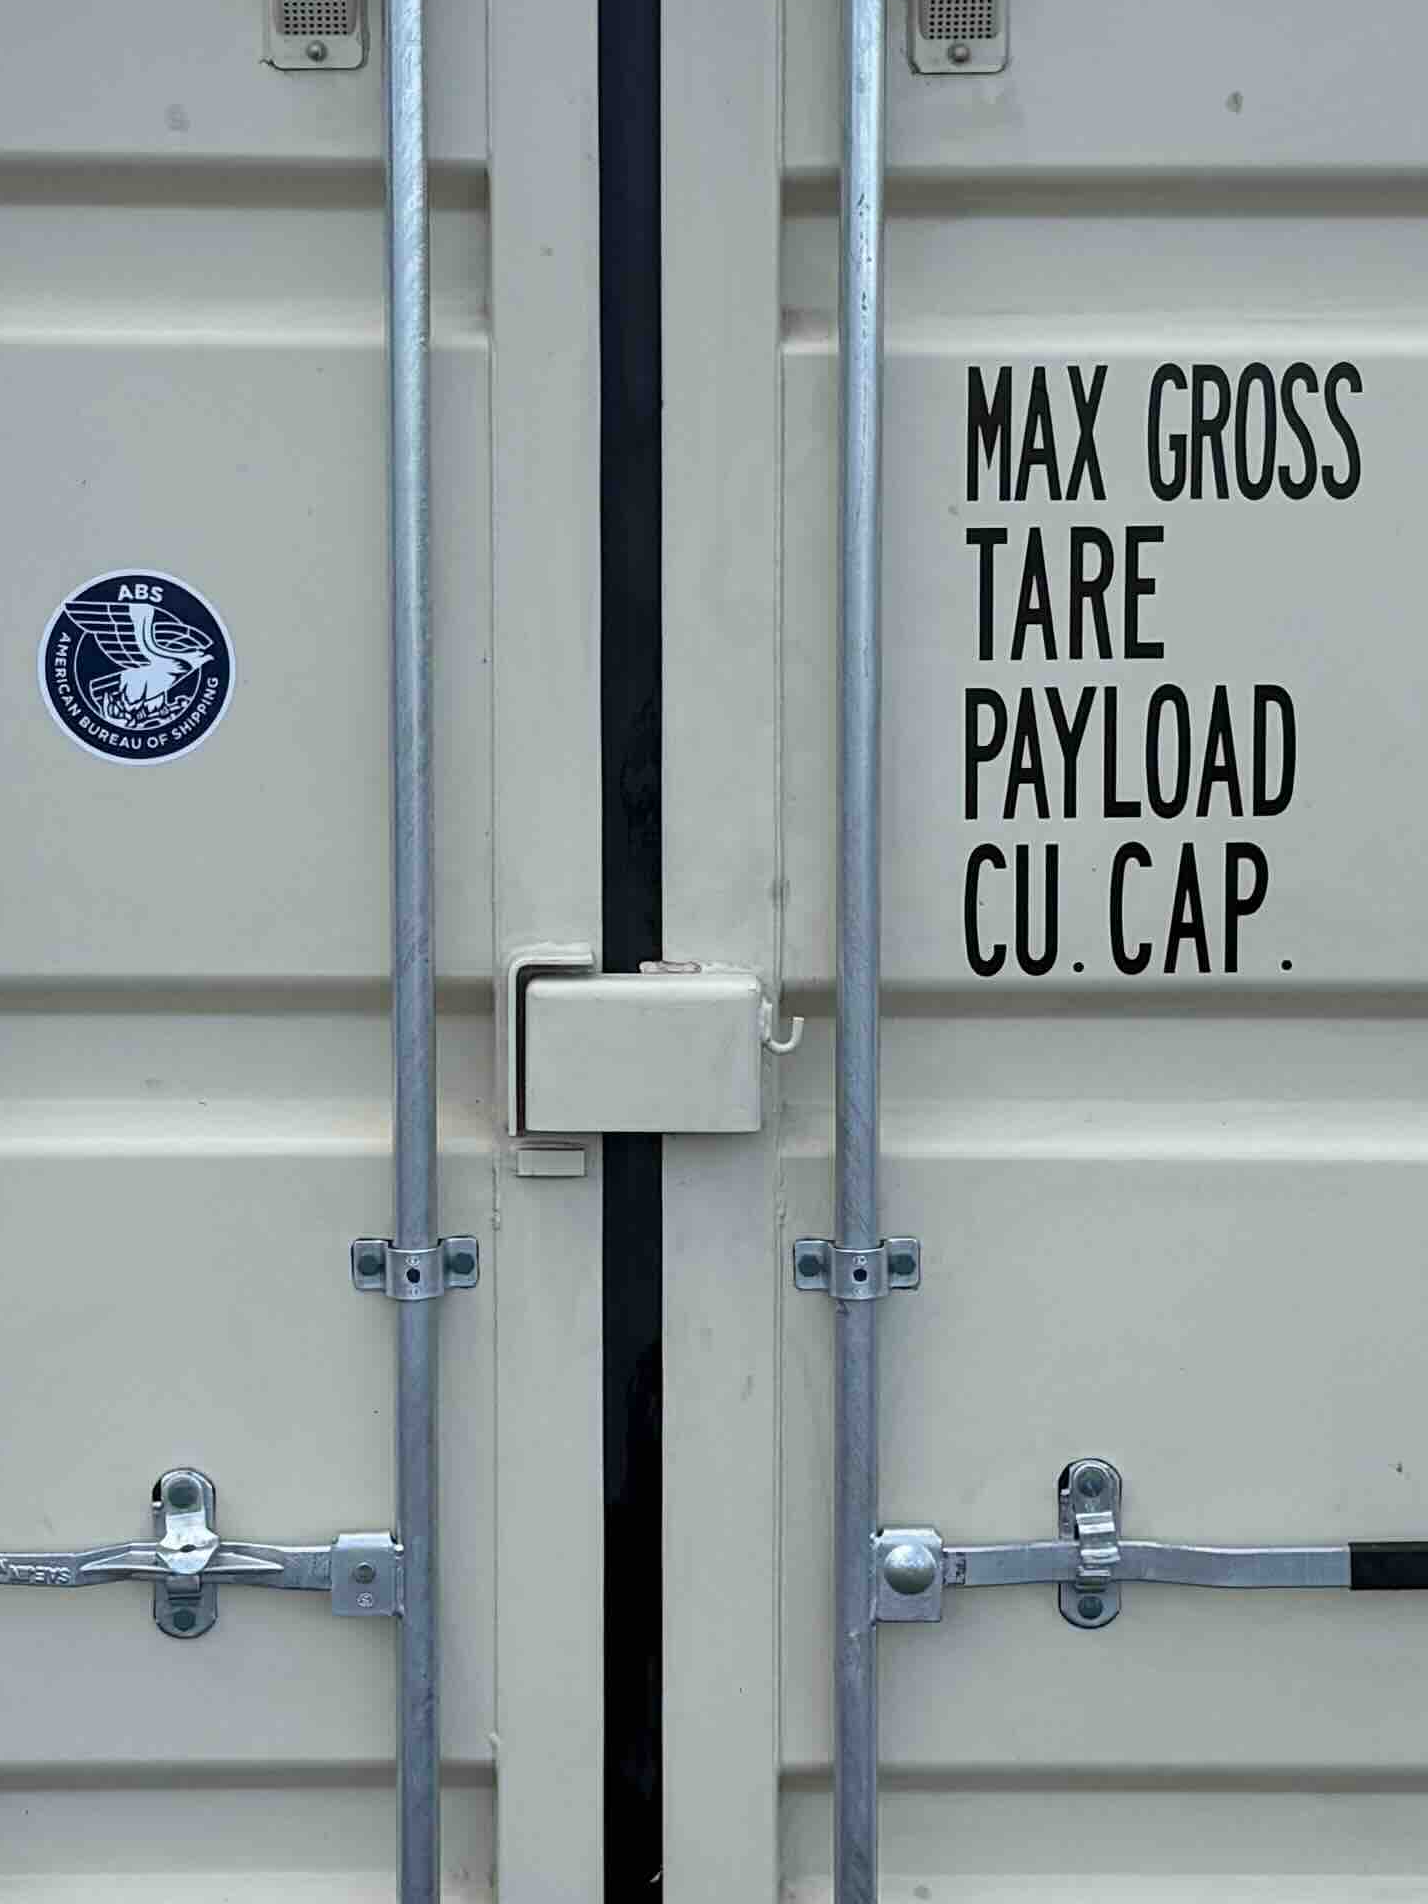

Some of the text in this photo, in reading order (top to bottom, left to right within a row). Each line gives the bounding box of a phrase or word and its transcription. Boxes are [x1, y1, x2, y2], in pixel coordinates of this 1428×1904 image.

[967, 362, 1362, 501] MAX GROSS
[117, 583, 164, 603] ABS
[966, 526, 1164, 660] TARE
[53, 631, 220, 750] AMERICAN BUREAU OF SHIPPING
[965, 684, 1296, 819] PAYLOAD
